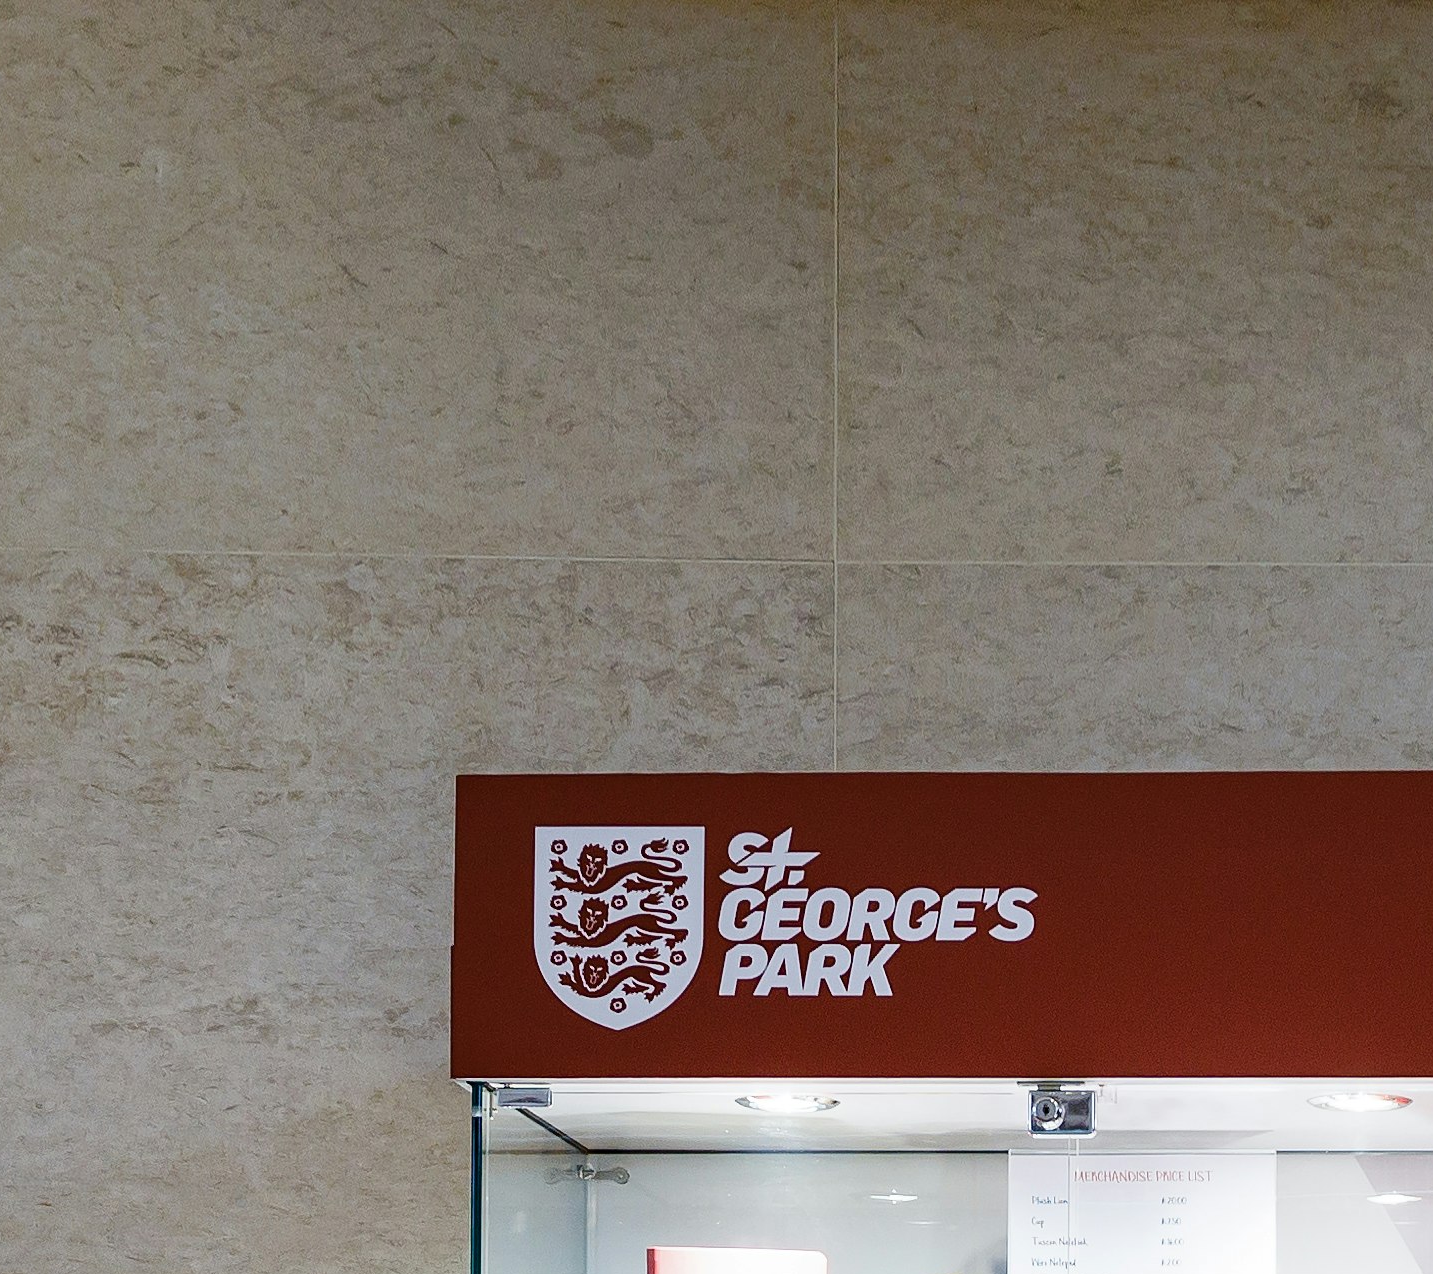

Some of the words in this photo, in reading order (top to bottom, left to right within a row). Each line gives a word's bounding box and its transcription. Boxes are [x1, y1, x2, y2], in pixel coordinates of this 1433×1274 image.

[719, 887, 1038, 943] GEORGE'S
[719, 943, 900, 997] PARK
[1074, 1170, 1153, 1183] MERCHANDISE
[1155, 1170, 1185, 1182] PRICE
[1187, 1170, 1213, 1182] LIST
